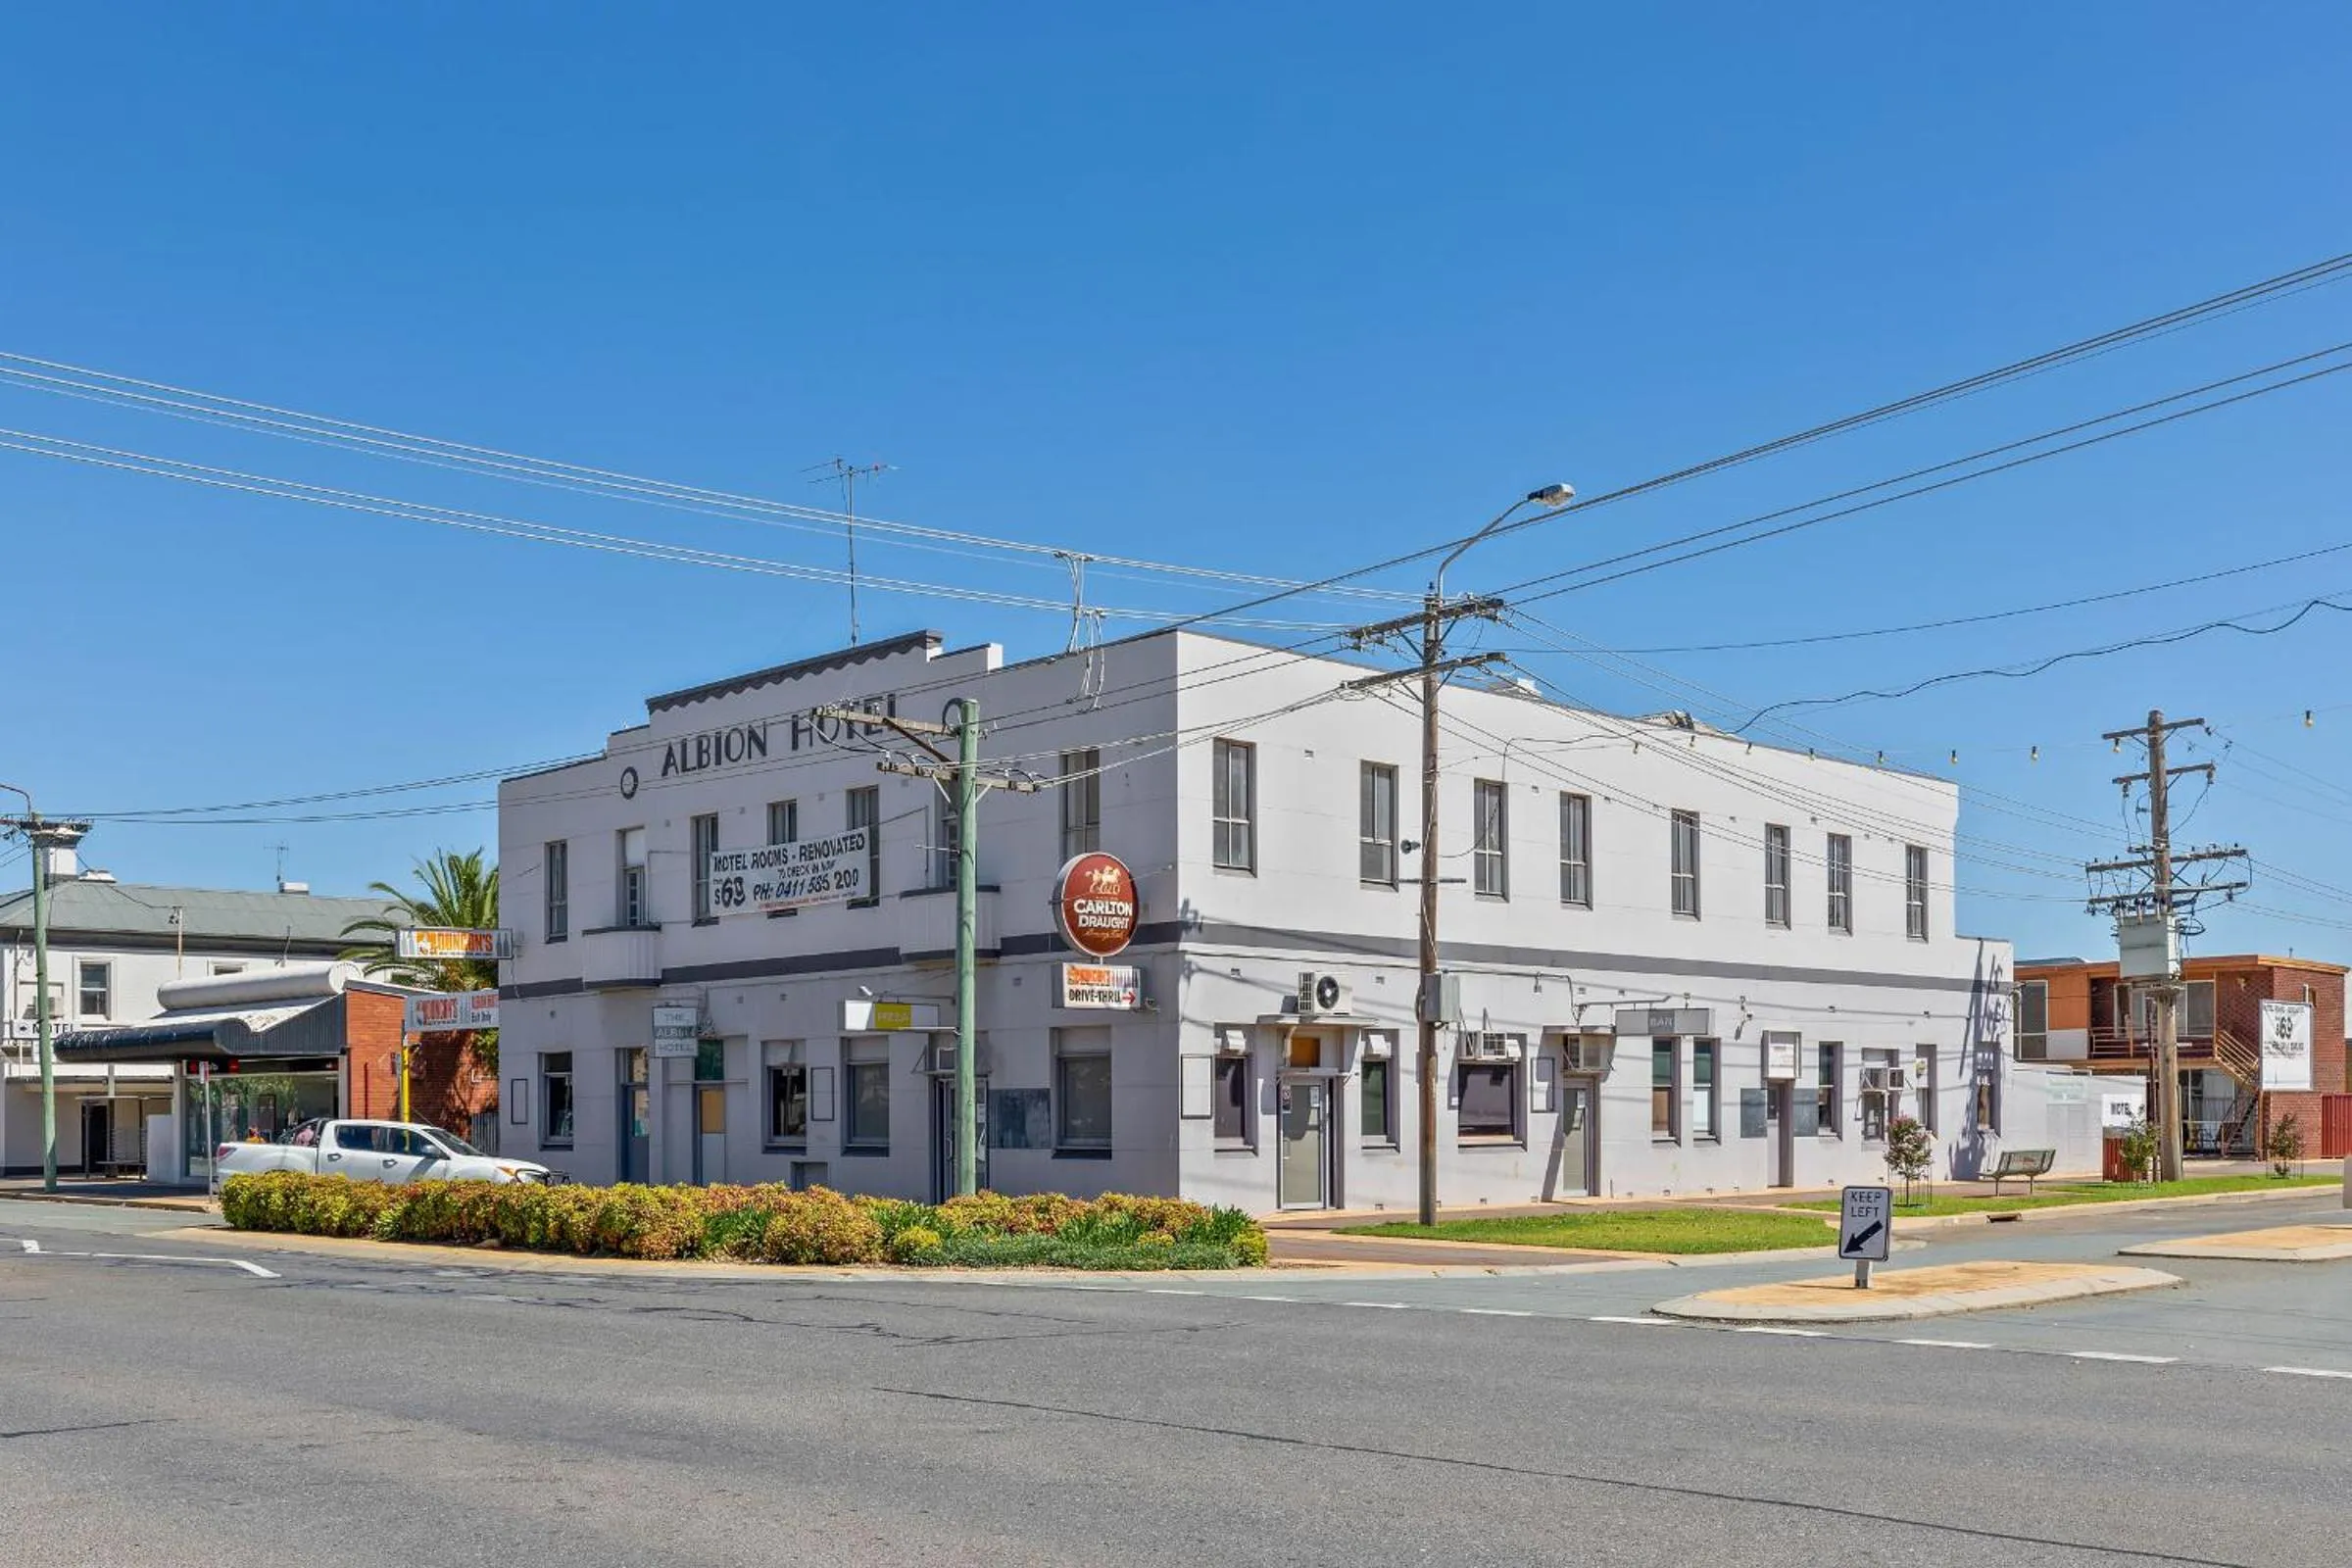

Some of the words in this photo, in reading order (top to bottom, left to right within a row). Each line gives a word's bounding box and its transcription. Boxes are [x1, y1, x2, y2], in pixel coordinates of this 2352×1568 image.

[662, 721, 767, 776] ALBION
[714, 853, 748, 872] MOTEL
[751, 848, 788, 869] ROOMS
[799, 833, 865, 862] RENOVATED
[775, 878, 806, 898] 0411
[834, 868, 858, 890] 200
[1073, 899, 1133, 916] CARLTON
[1078, 914, 1130, 930] DRAUGHT
[1068, 988, 1121, 1004] DRIVE-THRU
[1851, 1191, 1882, 1203] KEEP
[1851, 1206, 1880, 1218] LEFT
